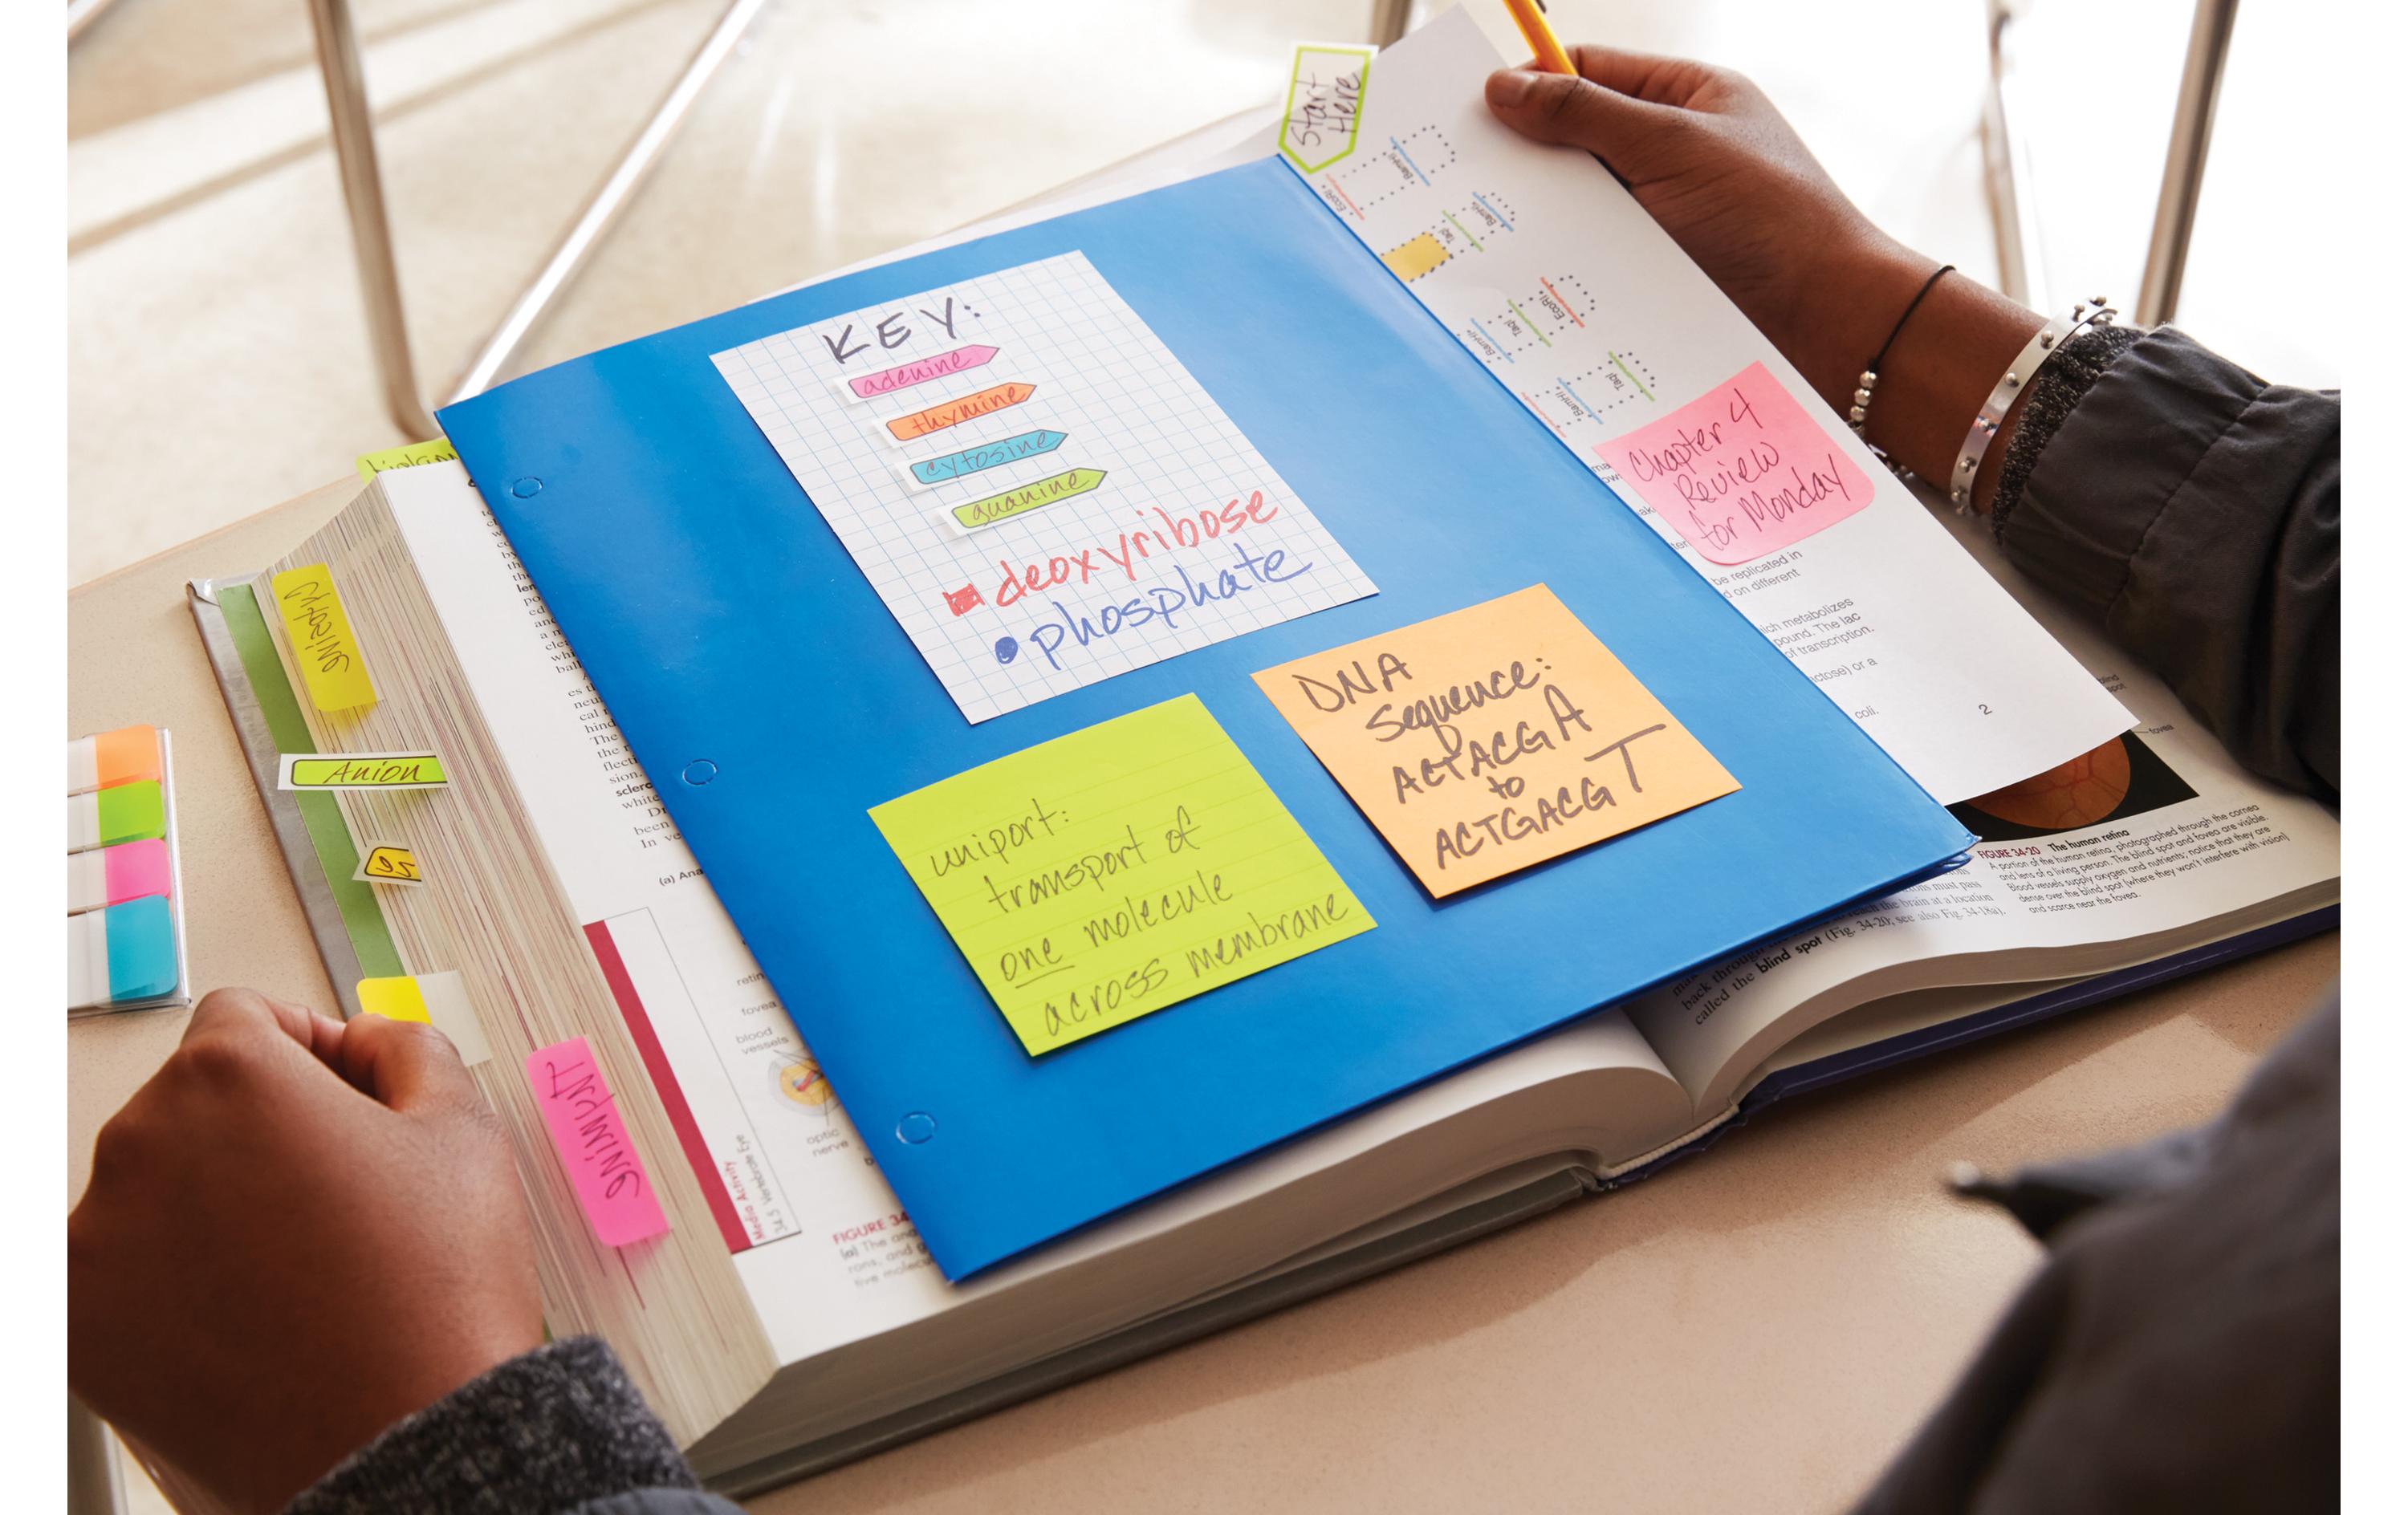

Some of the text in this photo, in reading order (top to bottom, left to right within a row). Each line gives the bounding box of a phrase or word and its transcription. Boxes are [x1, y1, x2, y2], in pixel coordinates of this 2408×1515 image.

[823, 297, 981, 364] KEY:
[860, 347, 973, 394] adenine
[911, 382, 1027, 436] thymine
[925, 429, 1063, 478] cytosine
[1629, 388, 1763, 481] Chapter 4
[1674, 442, 1780, 510] Review
[970, 472, 1091, 527] guanine
[1689, 453, 1850, 551] for Monday
[995, 490, 1279, 609] deoxyribose
[1710, 550, 1803, 586] be replicated in
[1734, 586, 1751, 596] on
[1751, 568, 1800, 591] different
[1030, 542, 1312, 670] phosphate
[1782, 598, 1854, 629] metabolizes
[1773, 612, 1861, 648] pound. The lac
[1784, 626, 1875, 659] of transcription.
[1291, 652, 1413, 713] DNA
[1852, 661, 1865, 671] or
[1867, 658, 1878, 666] a
[1855, 706, 1879, 719] coli.
[1979, 703, 1993, 716] 2
[590, 733, 618, 745] The
[597, 746, 620, 758] the
[323, 762, 420, 784] Anion
[1488, 776, 1525, 798] to
[634, 820, 669, 835] been
[931, 798, 1070, 878] uniport:
[1977, 830, 2129, 859] FIGURE 34-20 The human retina
[1989, 804, 2260, 872] A portion of the human retina, photographed through the cornea
[1999, 871, 2015, 881] and
[2017, 869, 2034, 880] lens
[2036, 868, 2045, 877] of
[2055, 865, 2080, 878] living
[2081, 859, 2113, 873] person.
[2111, 854, 2130, 864] The
[2132, 847, 2154, 859] blind
[2156, 843, 2175, 854] spot
[2176, 837, 2194, 848] and
[2195, 829, 2221, 841] fovea
[2222, 824, 2237, 833] are
[2238, 814, 2269, 827] visible.
[984, 805, 1202, 912] transport of
[2007, 826, 2271, 892] Blood vessels supply oxygen and nutrients; notice that they are
[2019, 893, 2044, 903] dense
[2046, 890, 2064, 900] over
[2065, 887, 2080, 897] the
[2081, 883, 2104, 896] blind
[2105, 879, 2124, 892] spot
[2124, 871, 2155, 888] (where
[2155, 864, 2176, 877] they
[2203, 847, 2239, 865] interfere
[2239, 840, 2260, 852] with
[2260, 832, 2290, 847] vision)
[1881, 899, 1900, 911] the
[1902, 896, 1930, 908] brain
[1930, 896, 1943, 905] at
[1953, 892, 1994, 904] location
[2029, 890, 2141, 913] and scarce near the fovea.
[1000, 871, 1233, 981] one molecule
[1045, 893, 1349, 1037] across membrane
[1694, 988, 1731, 1026] called
[1732, 972, 1755, 991] the
[1755, 948, 1792, 975] blind
[1795, 936, 1823, 954] spot
[1896, 915, 1915, 924] see
[1682, 983, 1712, 1011] back
[735, 1027, 773, 1044] blood
[741, 1036, 790, 1055] vessels
[806, 1127, 840, 1145] optic
